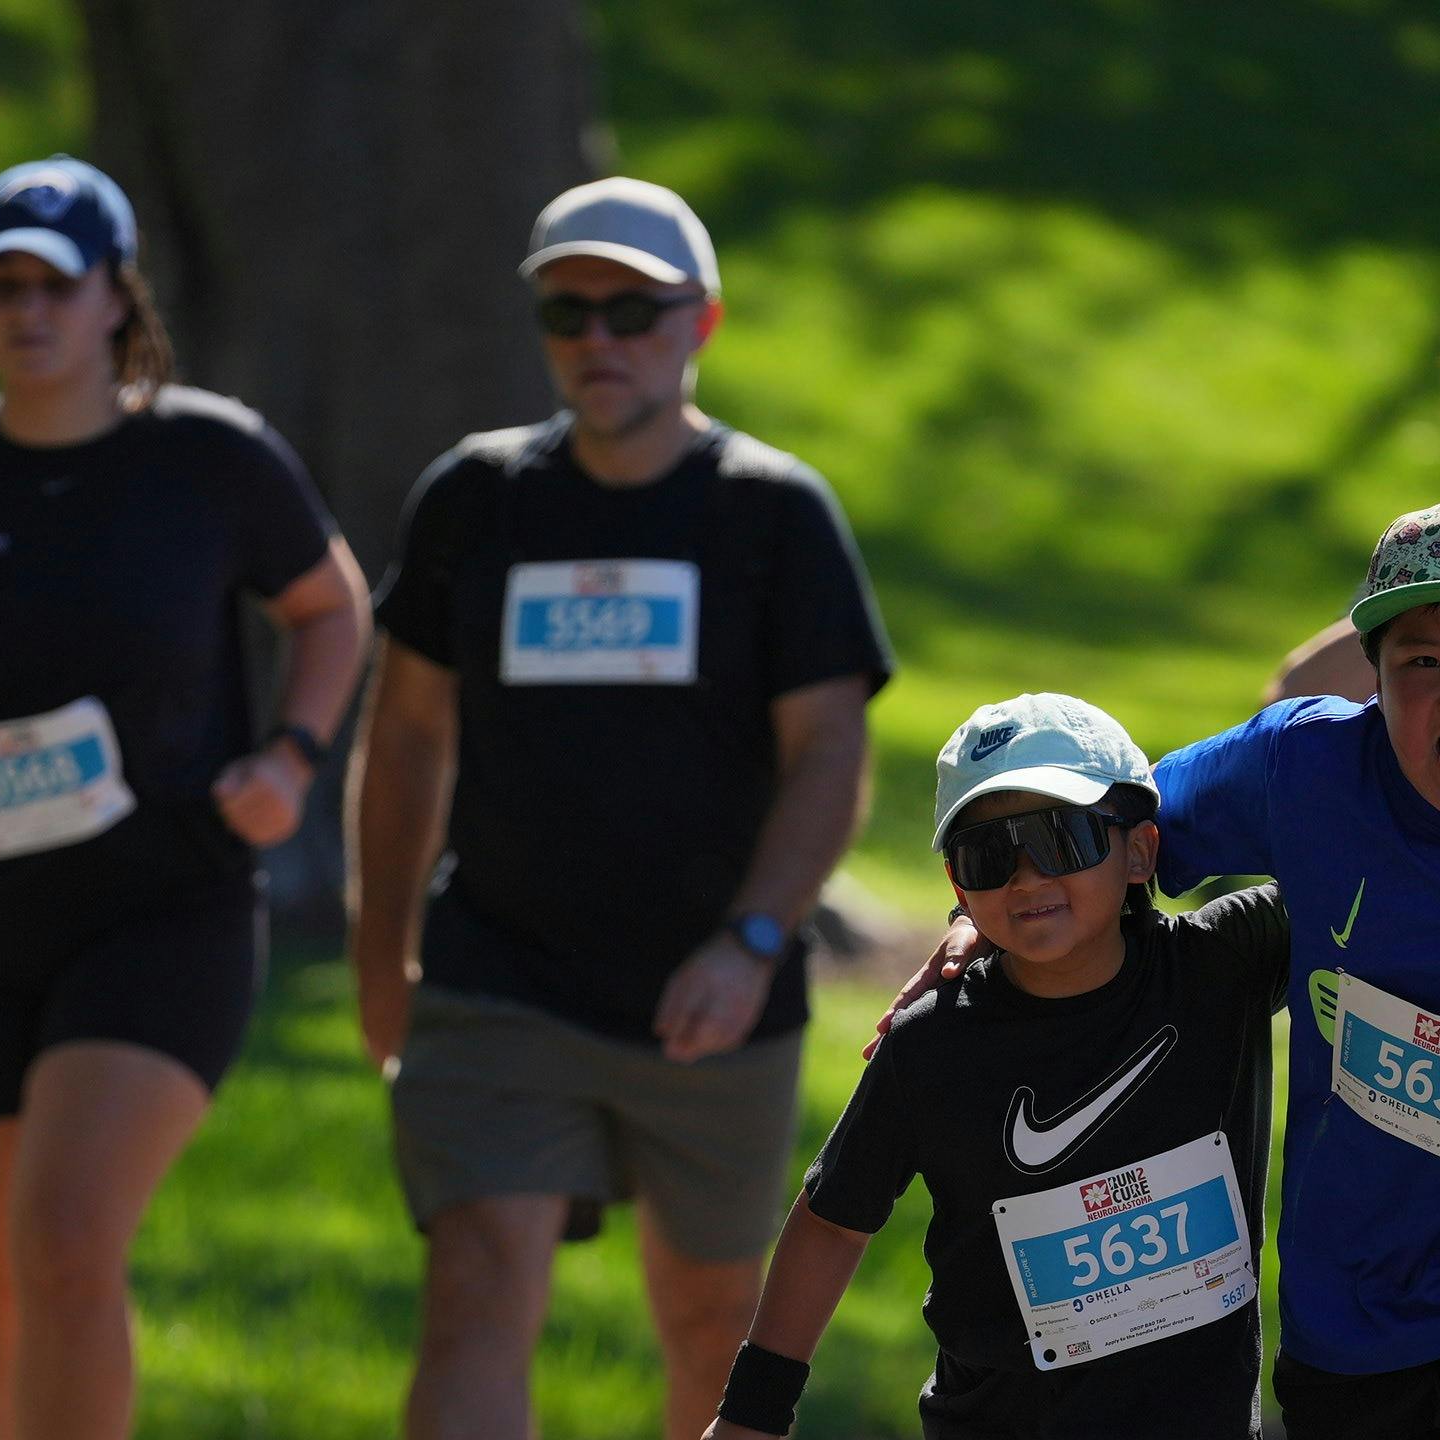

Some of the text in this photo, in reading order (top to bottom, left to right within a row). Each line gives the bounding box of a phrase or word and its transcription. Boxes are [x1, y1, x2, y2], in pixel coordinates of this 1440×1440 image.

[978, 726, 1014, 749] NIKE
[1380, 1095, 1420, 1119] GHELLA
[1112, 1180, 1151, 1204] CURE
[1087, 1195, 1153, 1222] NEUROBLASTOMA
[1063, 1201, 1189, 1287] 5637
[1085, 1283, 1132, 1304] GHELLA
[1221, 1284, 1247, 1309] 5637
